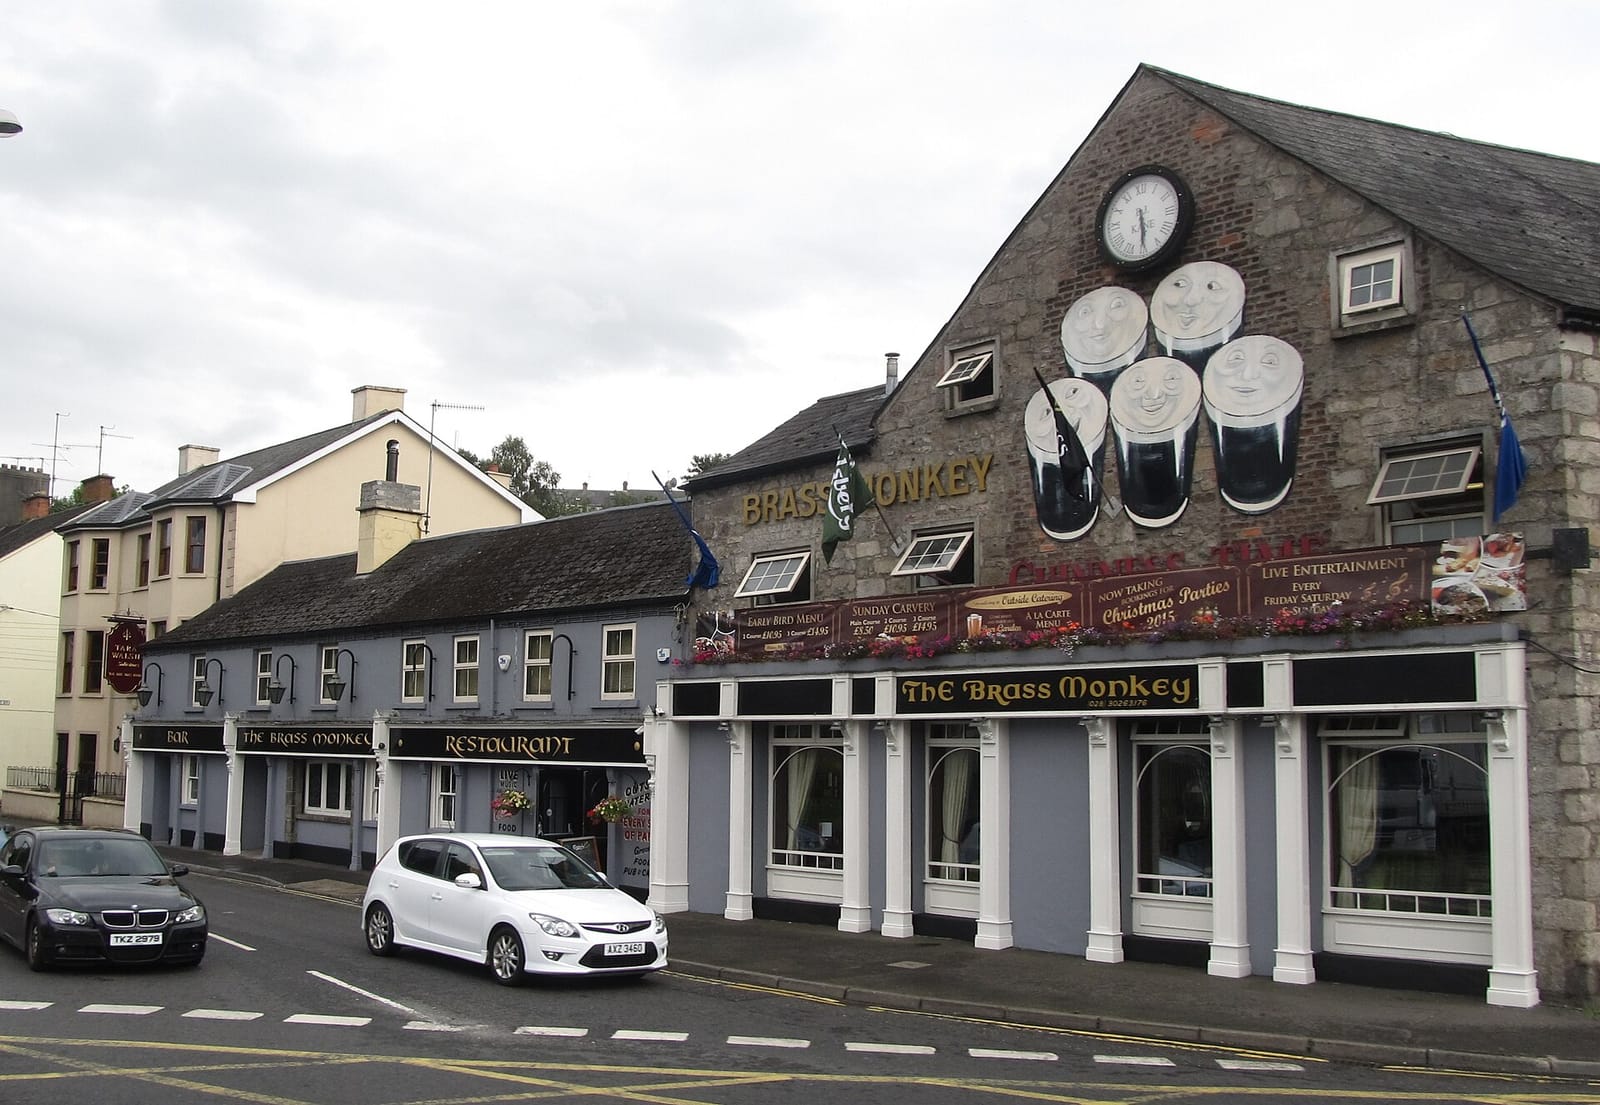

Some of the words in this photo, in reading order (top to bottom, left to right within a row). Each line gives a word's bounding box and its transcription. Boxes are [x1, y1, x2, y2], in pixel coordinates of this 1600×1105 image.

[742, 481, 830, 526] BRASS
[1262, 567, 1289, 579] LIVE
[1293, 557, 1408, 577] ENTERTAINMENT
[1098, 588, 1123, 603] NOW
[1126, 577, 1164, 595] TAKING
[1292, 581, 1322, 592] EVERY
[1001, 594, 1029, 606] Outside
[1031, 592, 1063, 604] Catering
[1103, 597, 1174, 625] Christmas
[1178, 580, 1230, 605] Parties
[1120, 590, 1158, 605] BOOKINGS
[1264, 595, 1298, 606] FRIDAY
[1301, 591, 1352, 603] SATURDAY
[852, 605, 890, 617] SUNDAY
[892, 602, 936, 614] CARVERY
[1025, 612, 1032, 620] A
[1033, 611, 1044, 620] LA
[1045, 609, 1071, 619] CARTE
[1292, 605, 1332, 616] SUDAY
[747, 616, 770, 627] EARLY
[773, 615, 794, 626] BIRD
[796, 613, 824, 624] MENU
[1035, 620, 1061, 629] MENU
[1146, 610, 1176, 630] 2015
[902, 679, 955, 703] The
[962, 680, 1051, 706] Brass
[1059, 674, 1191, 704] Monkey
[167, 729, 190, 745] BAR
[243, 729, 264, 745] THE
[270, 730, 308, 748] BRASS
[445, 734, 576, 760] RESTAURANT
[499, 769, 519, 780] LIVE
[625, 792, 651, 808] ATER
[498, 823, 517, 833] FOOD
[624, 830, 636, 841] OF
[113, 935, 133, 943] TKZ
[135, 934, 160, 943] 2979
[607, 945, 623, 954] AXZ
